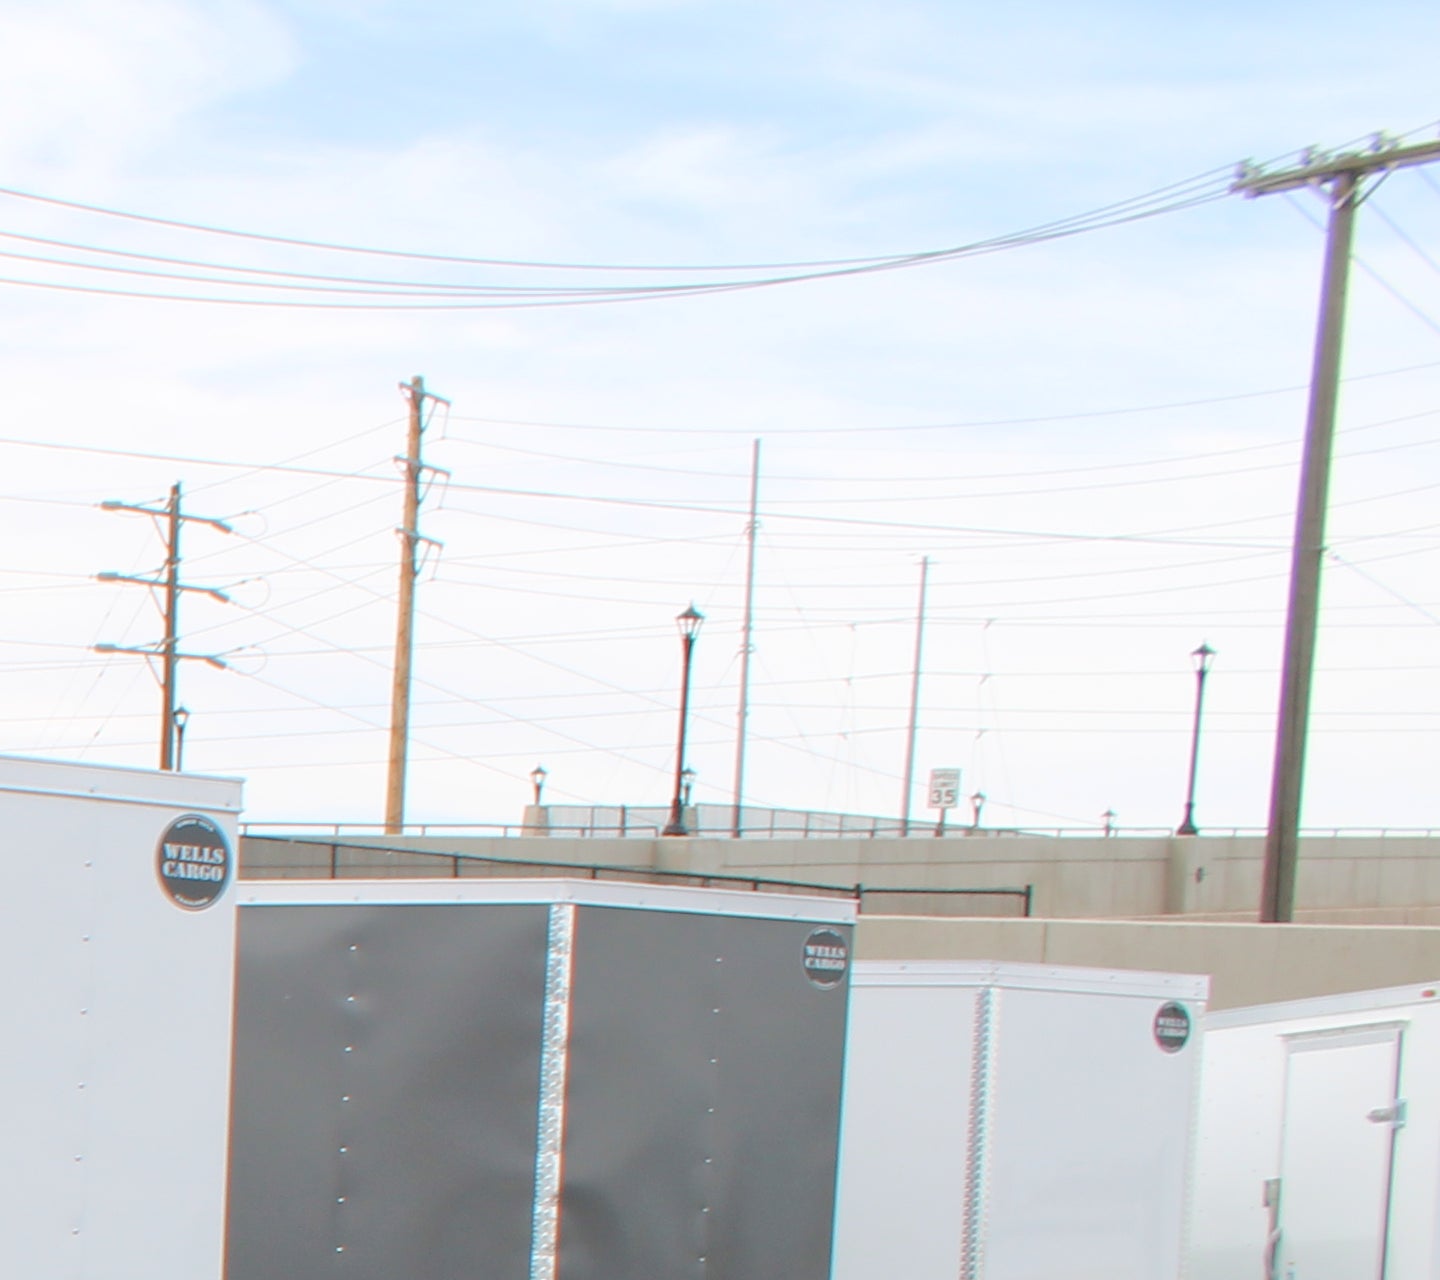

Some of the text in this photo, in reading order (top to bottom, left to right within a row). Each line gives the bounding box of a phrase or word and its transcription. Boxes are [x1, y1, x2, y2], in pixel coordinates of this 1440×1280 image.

[932, 789, 956, 804] 35
[163, 843, 225, 864] WELLS
[162, 861, 224, 882] CARGO
[805, 944, 846, 958] WELLS
[804, 957, 846, 970] CARGO
